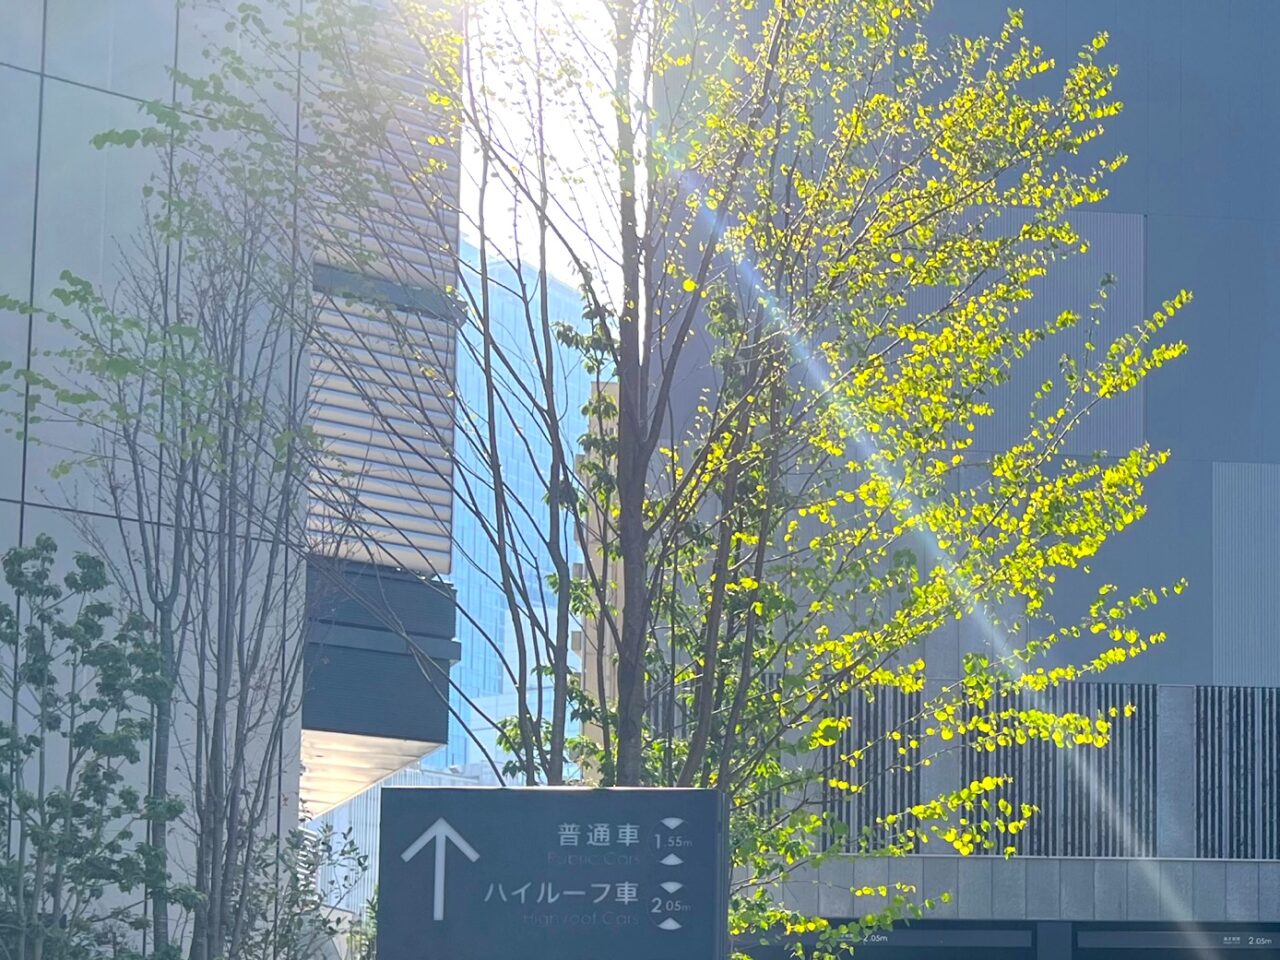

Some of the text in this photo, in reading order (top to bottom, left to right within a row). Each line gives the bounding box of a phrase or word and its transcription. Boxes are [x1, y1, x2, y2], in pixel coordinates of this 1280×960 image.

[557, 822, 641, 847] 普通車
[653, 833, 693, 849] 1.55m
[483, 881, 640, 906] ハイルーフ車
[650, 897, 691, 914] 2.05m
